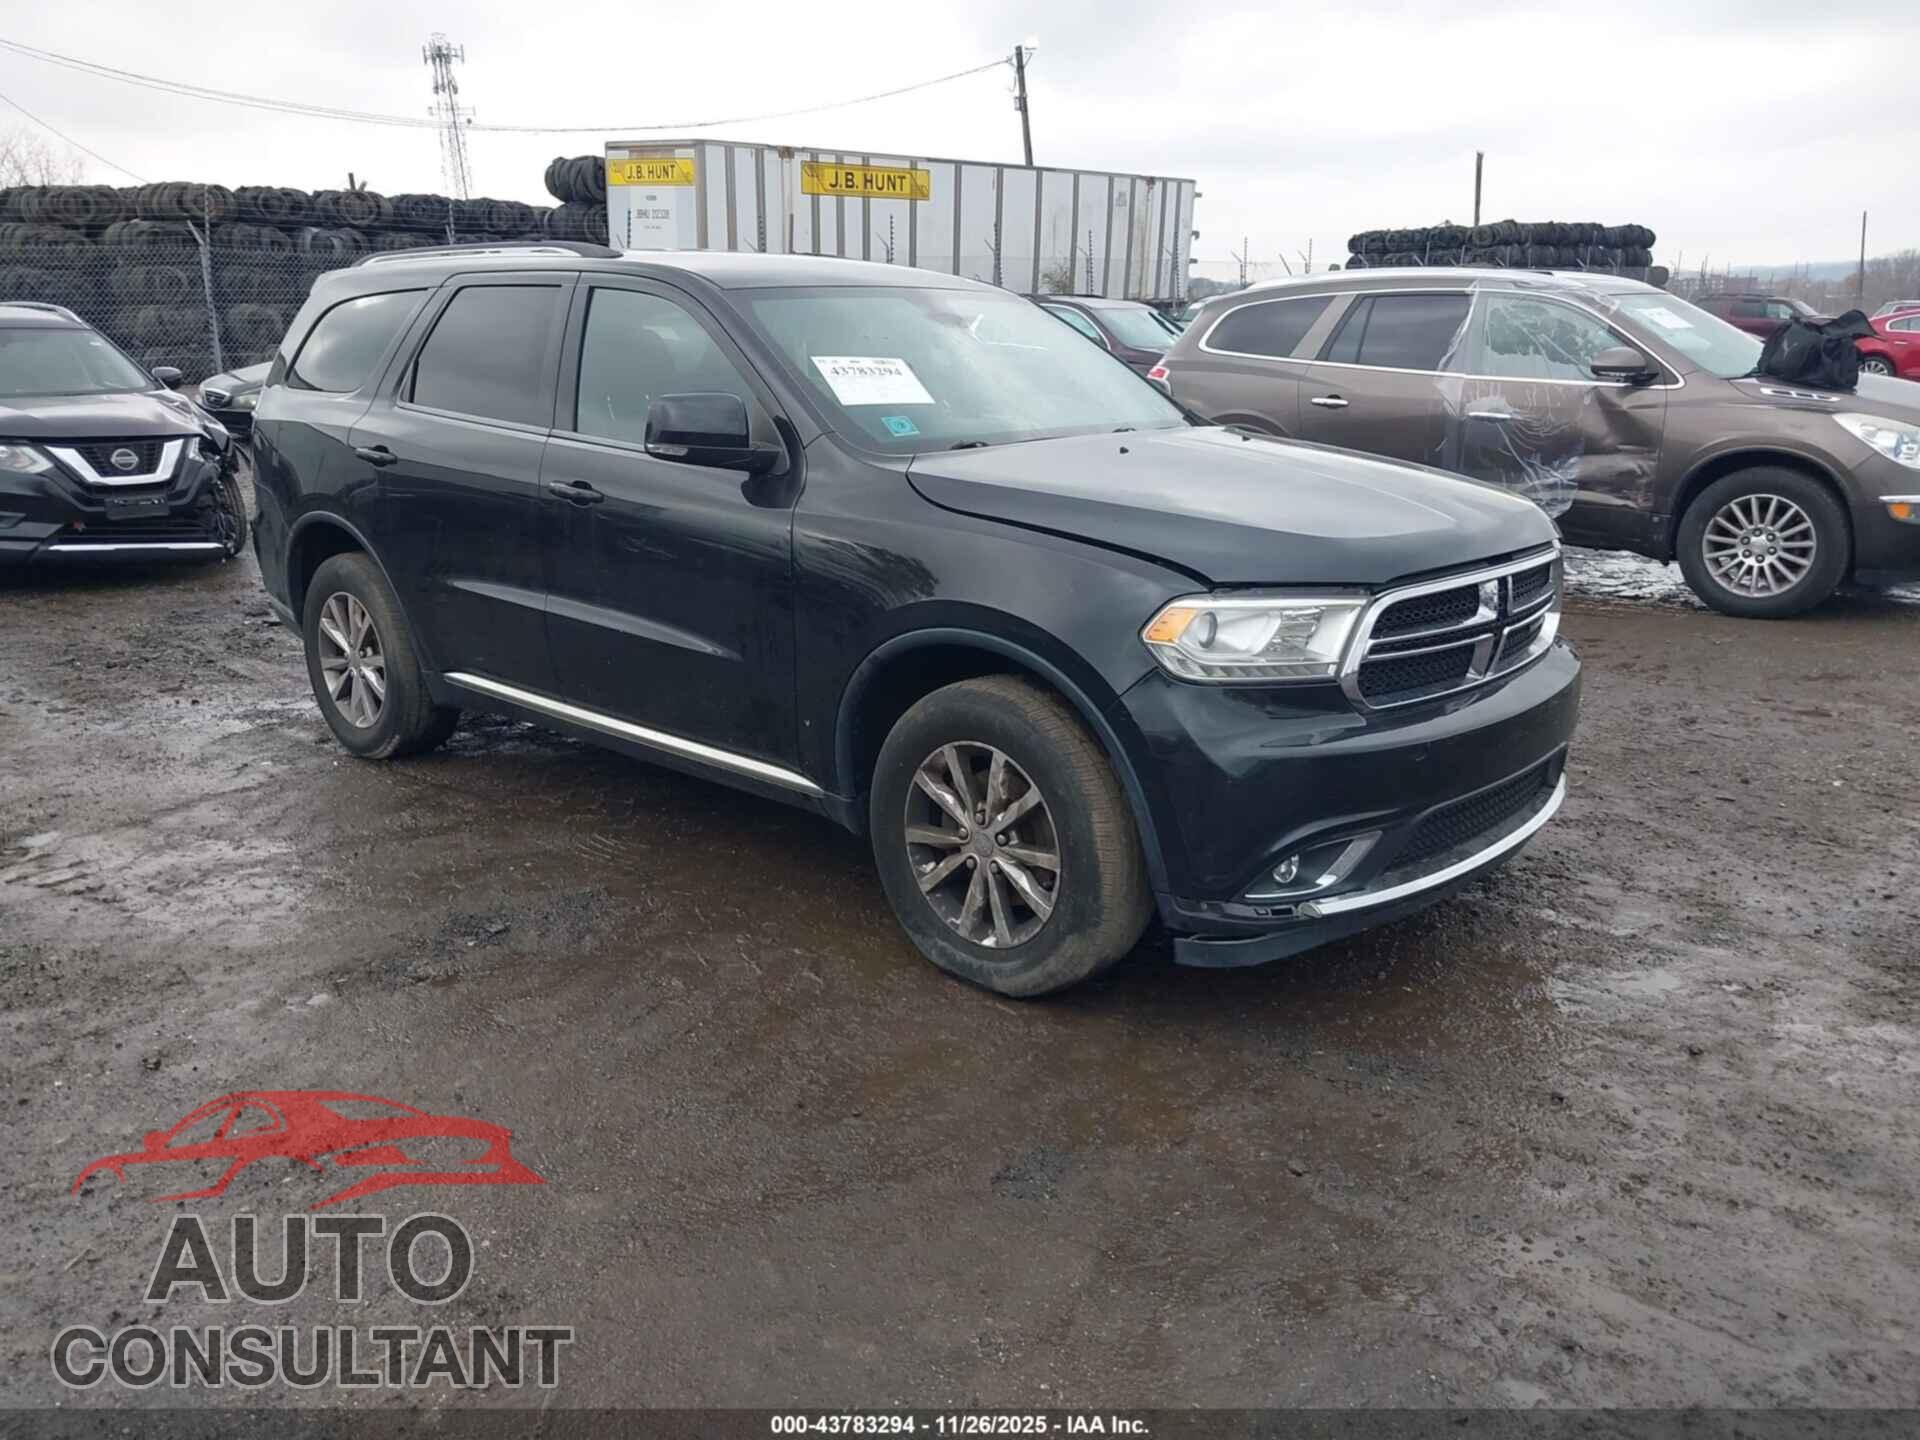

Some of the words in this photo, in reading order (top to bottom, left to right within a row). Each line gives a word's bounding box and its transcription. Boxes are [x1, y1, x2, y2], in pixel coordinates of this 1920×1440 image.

[627, 165, 646, 179] J.B.
[647, 164, 676, 180] HUNT
[829, 170, 859, 190] J.B.
[862, 172, 907, 192] HUNT
[831, 366, 903, 376] 43783294
